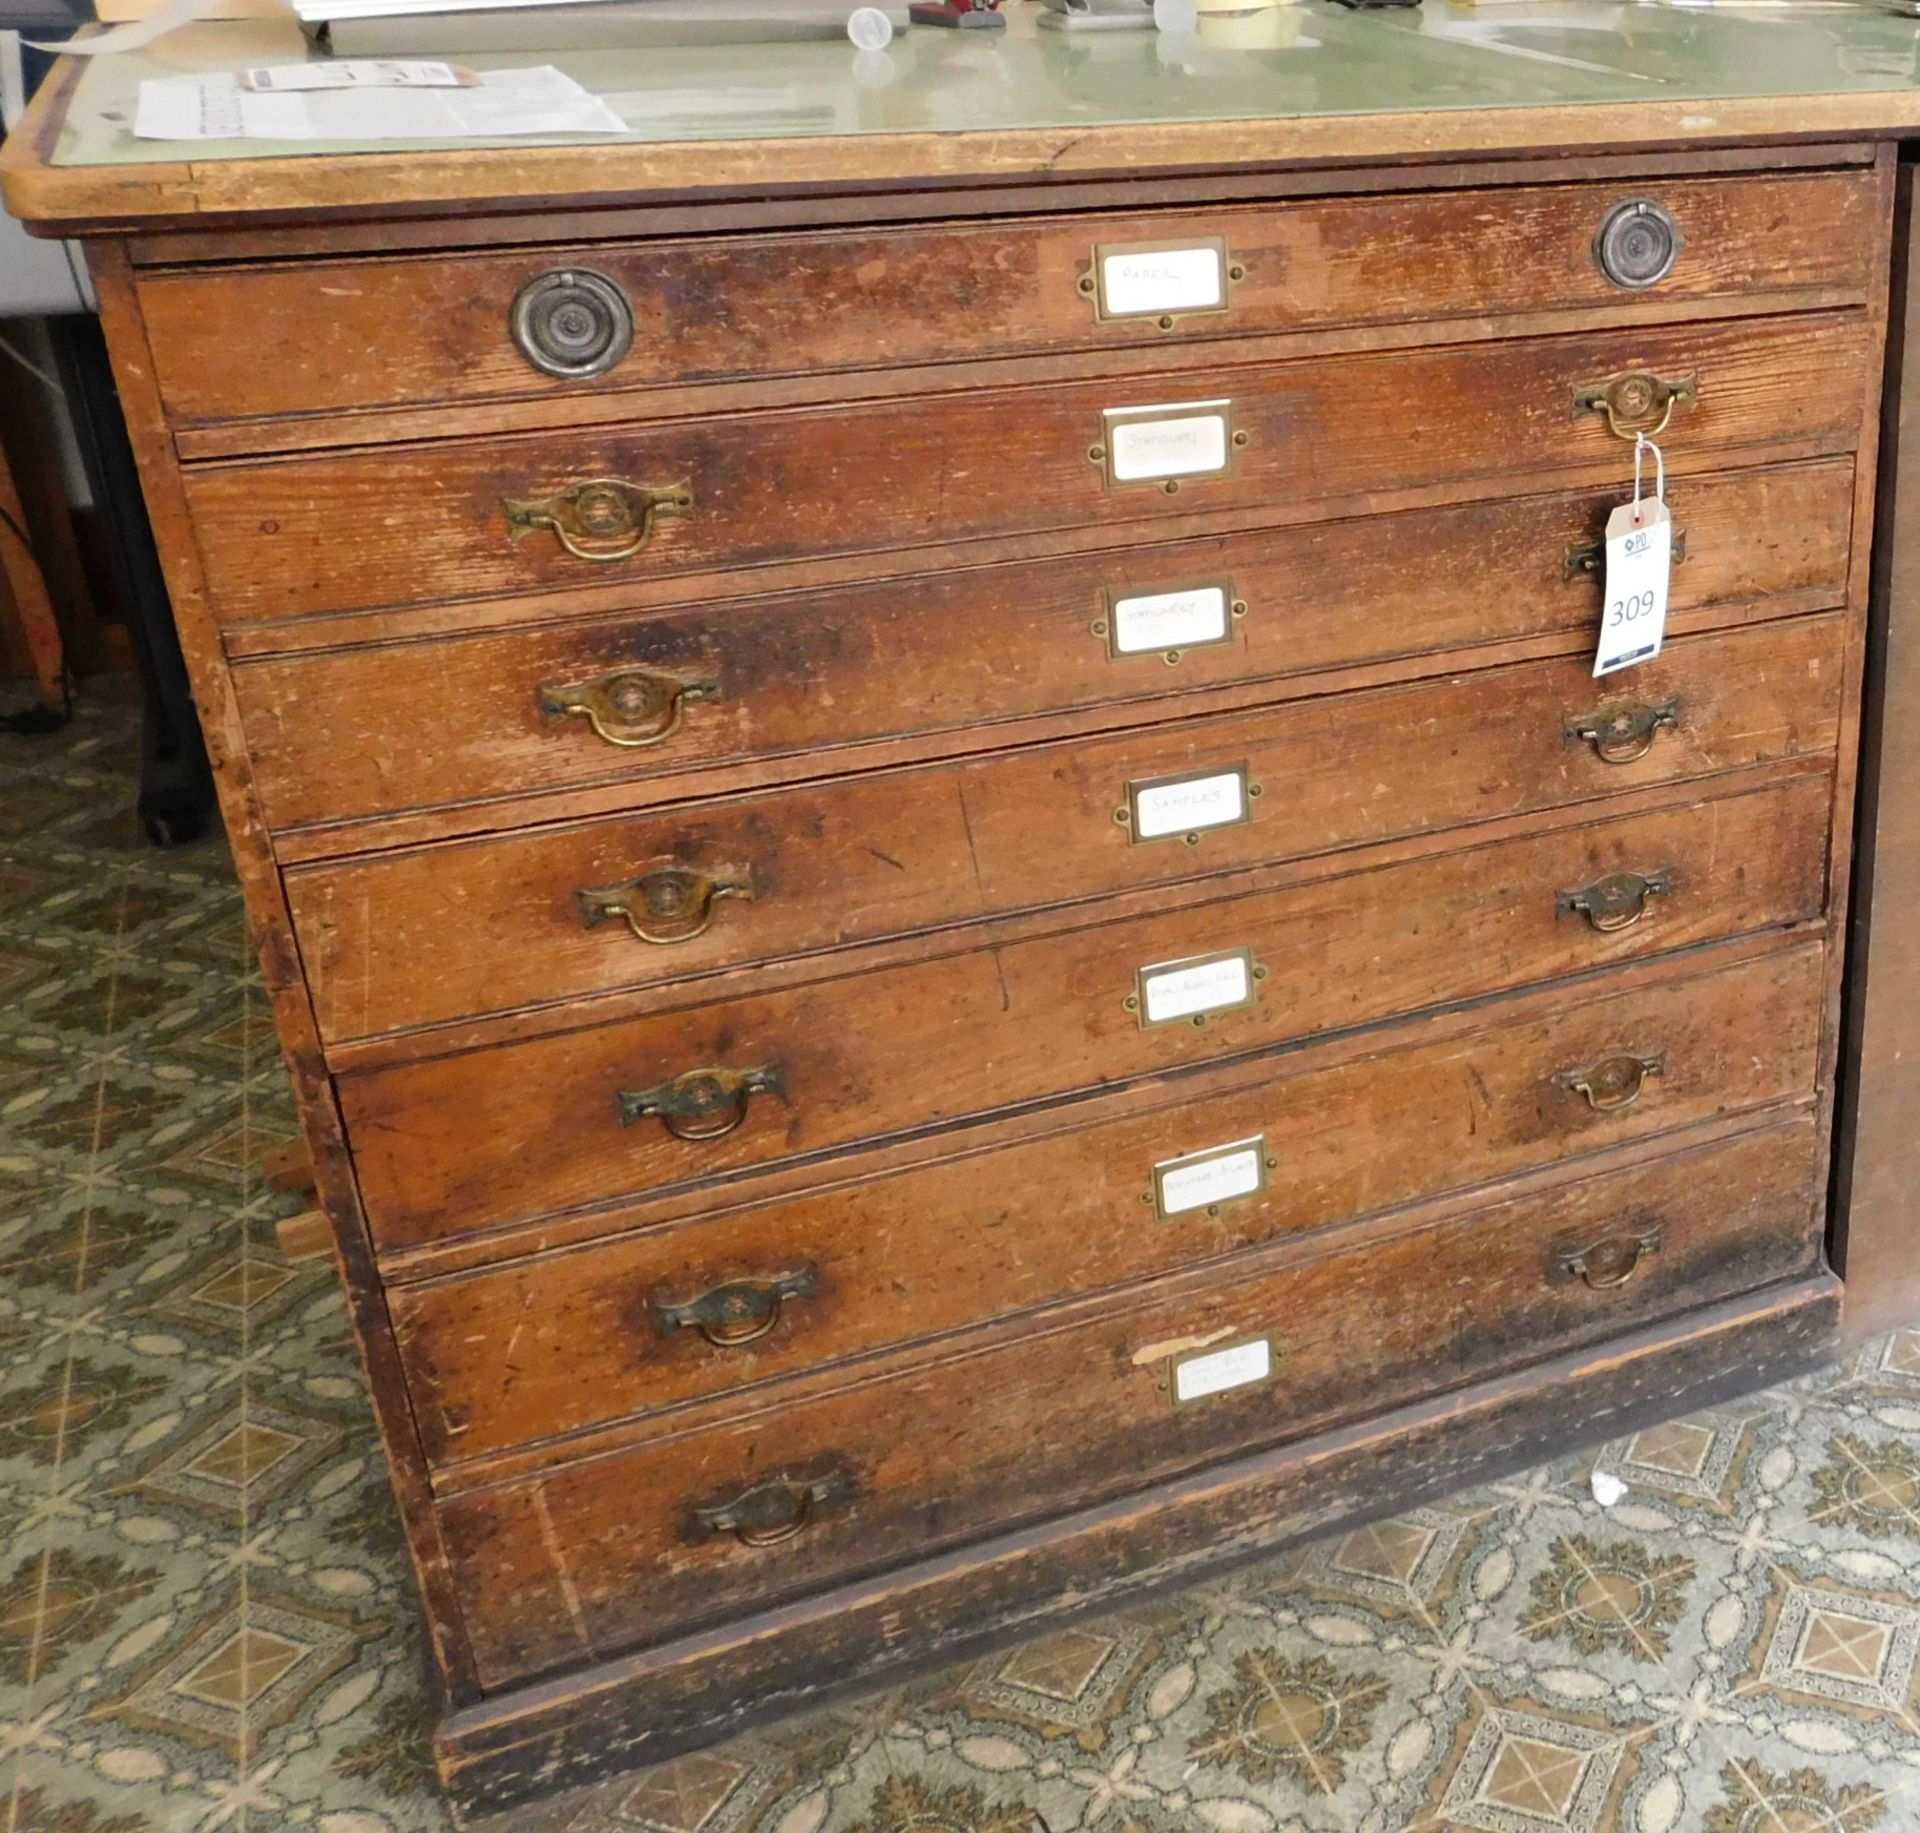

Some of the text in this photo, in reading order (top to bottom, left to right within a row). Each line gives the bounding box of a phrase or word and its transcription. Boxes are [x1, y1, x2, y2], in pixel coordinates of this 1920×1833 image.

[1122, 266, 1181, 281] PAPER
[1609, 589, 1655, 627] 309
[1152, 789, 1221, 810] SAMPLES
